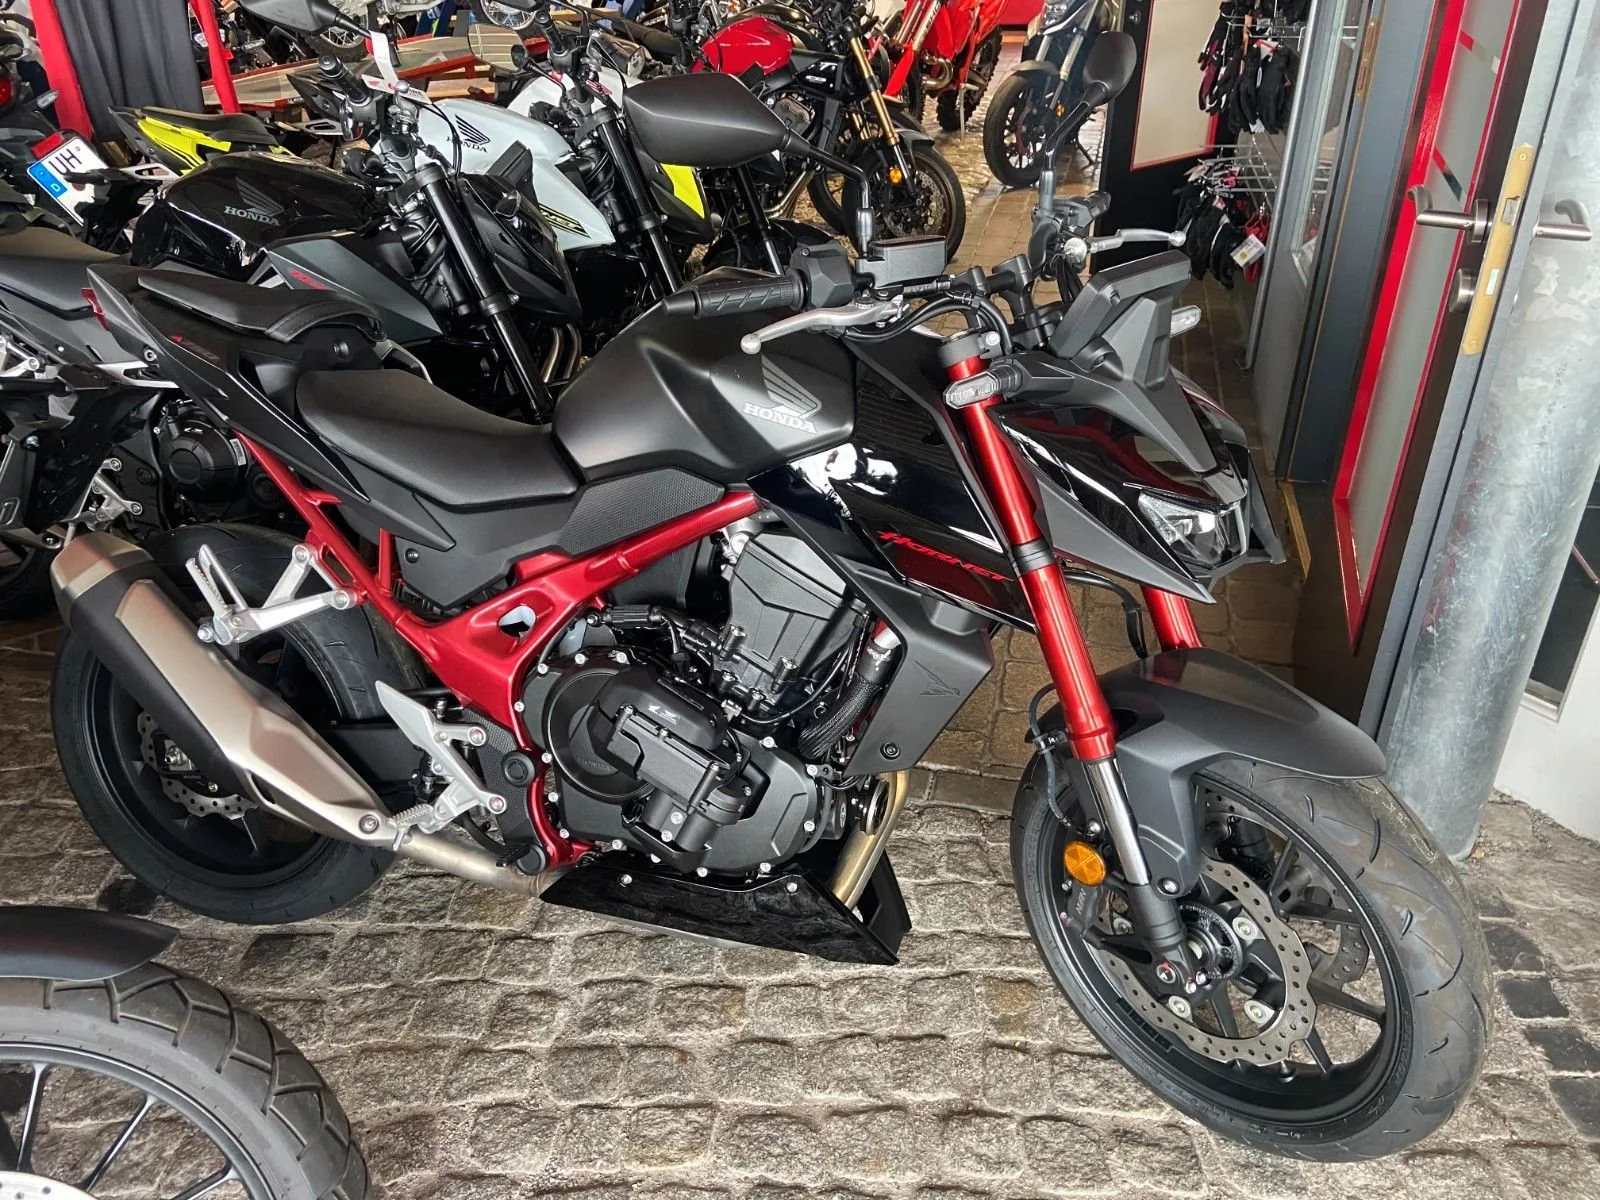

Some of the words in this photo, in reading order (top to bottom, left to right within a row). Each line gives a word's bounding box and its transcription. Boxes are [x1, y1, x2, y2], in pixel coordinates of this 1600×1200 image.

[446, 136, 488, 153] HNDA
[48, 148, 83, 175] UH
[223, 205, 281, 227] HONDA
[742, 401, 818, 435] HONDA
[877, 530, 1014, 582] HORNET
